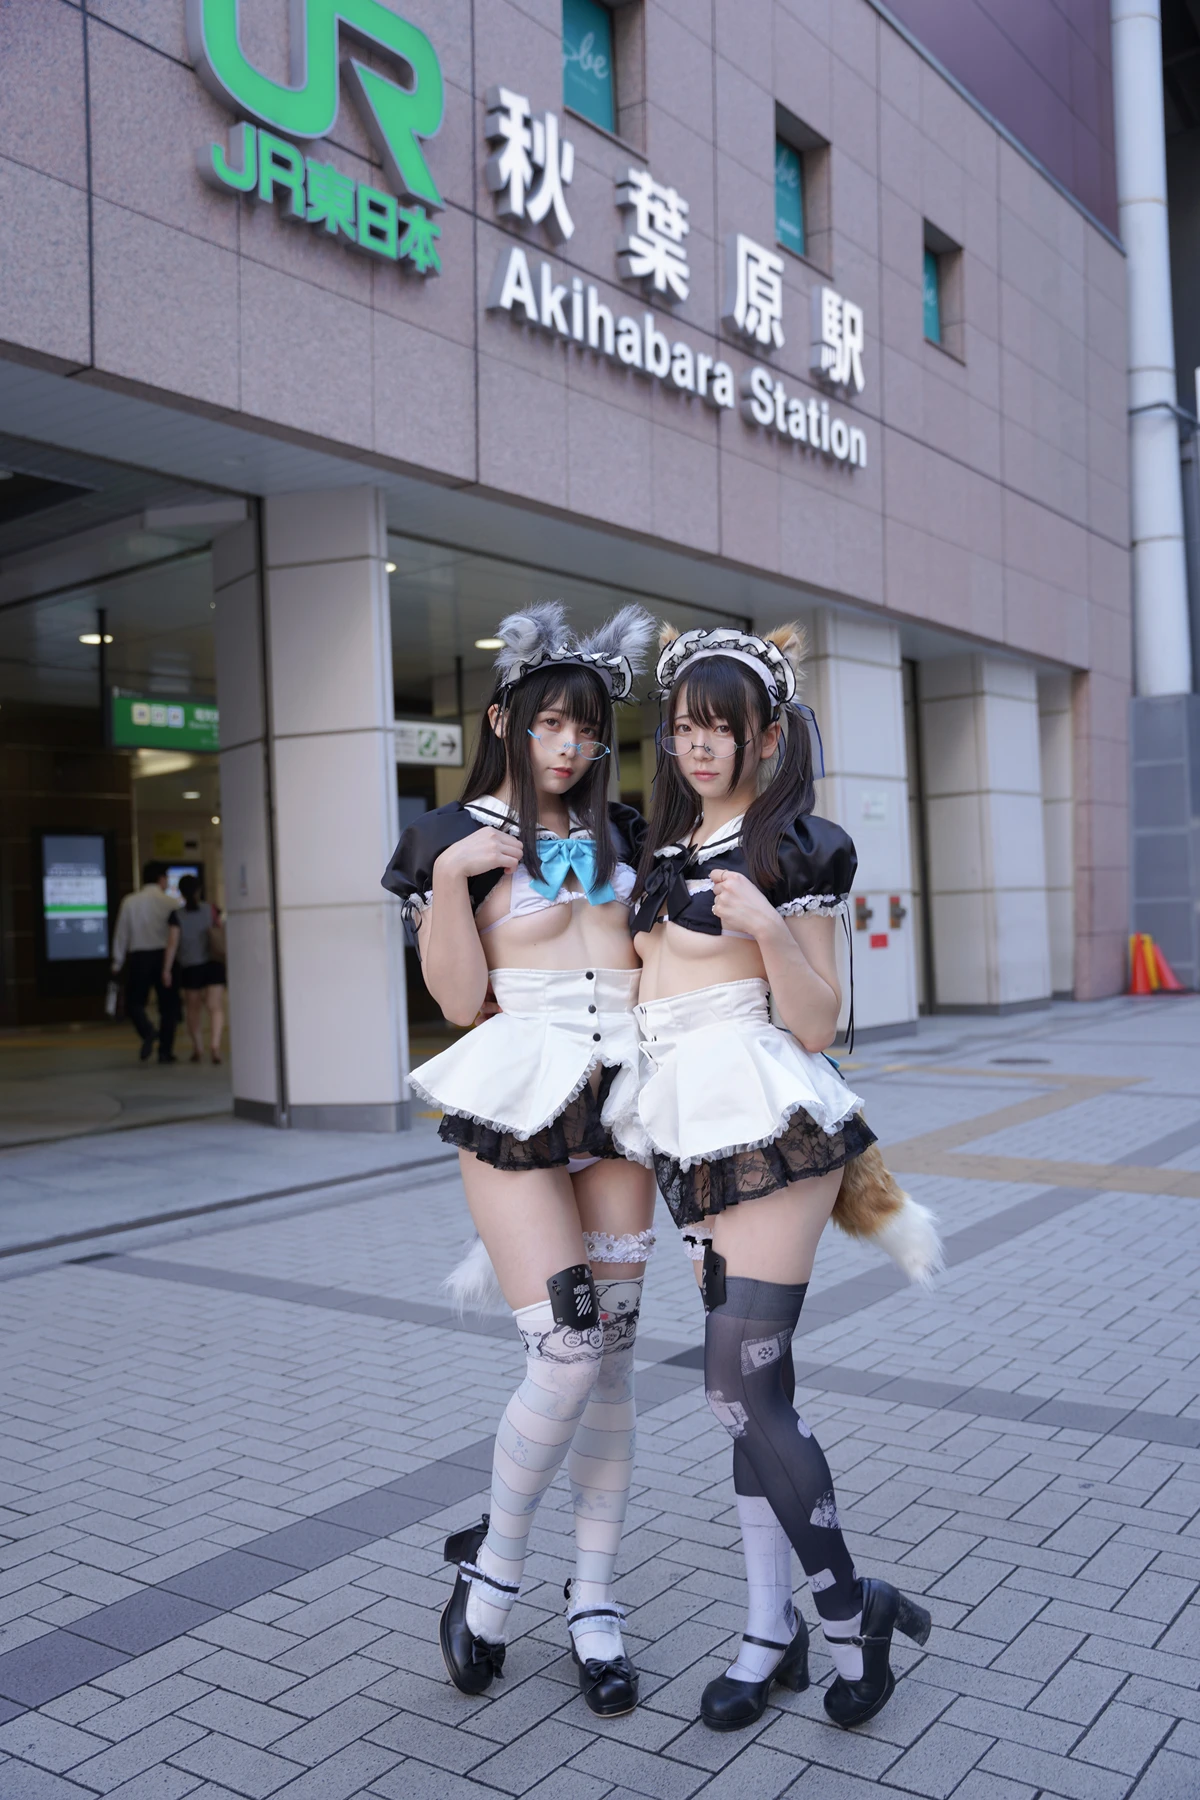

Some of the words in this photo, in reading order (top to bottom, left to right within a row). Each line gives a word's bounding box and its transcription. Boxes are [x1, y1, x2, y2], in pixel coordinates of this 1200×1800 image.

[201, 0, 445, 210] JR
[211, 121, 442, 275] JR東日本
[498, 87, 866, 393] 秋葉原駅
[499, 247, 735, 408] Akihabara
[748, 366, 868, 468] Station
